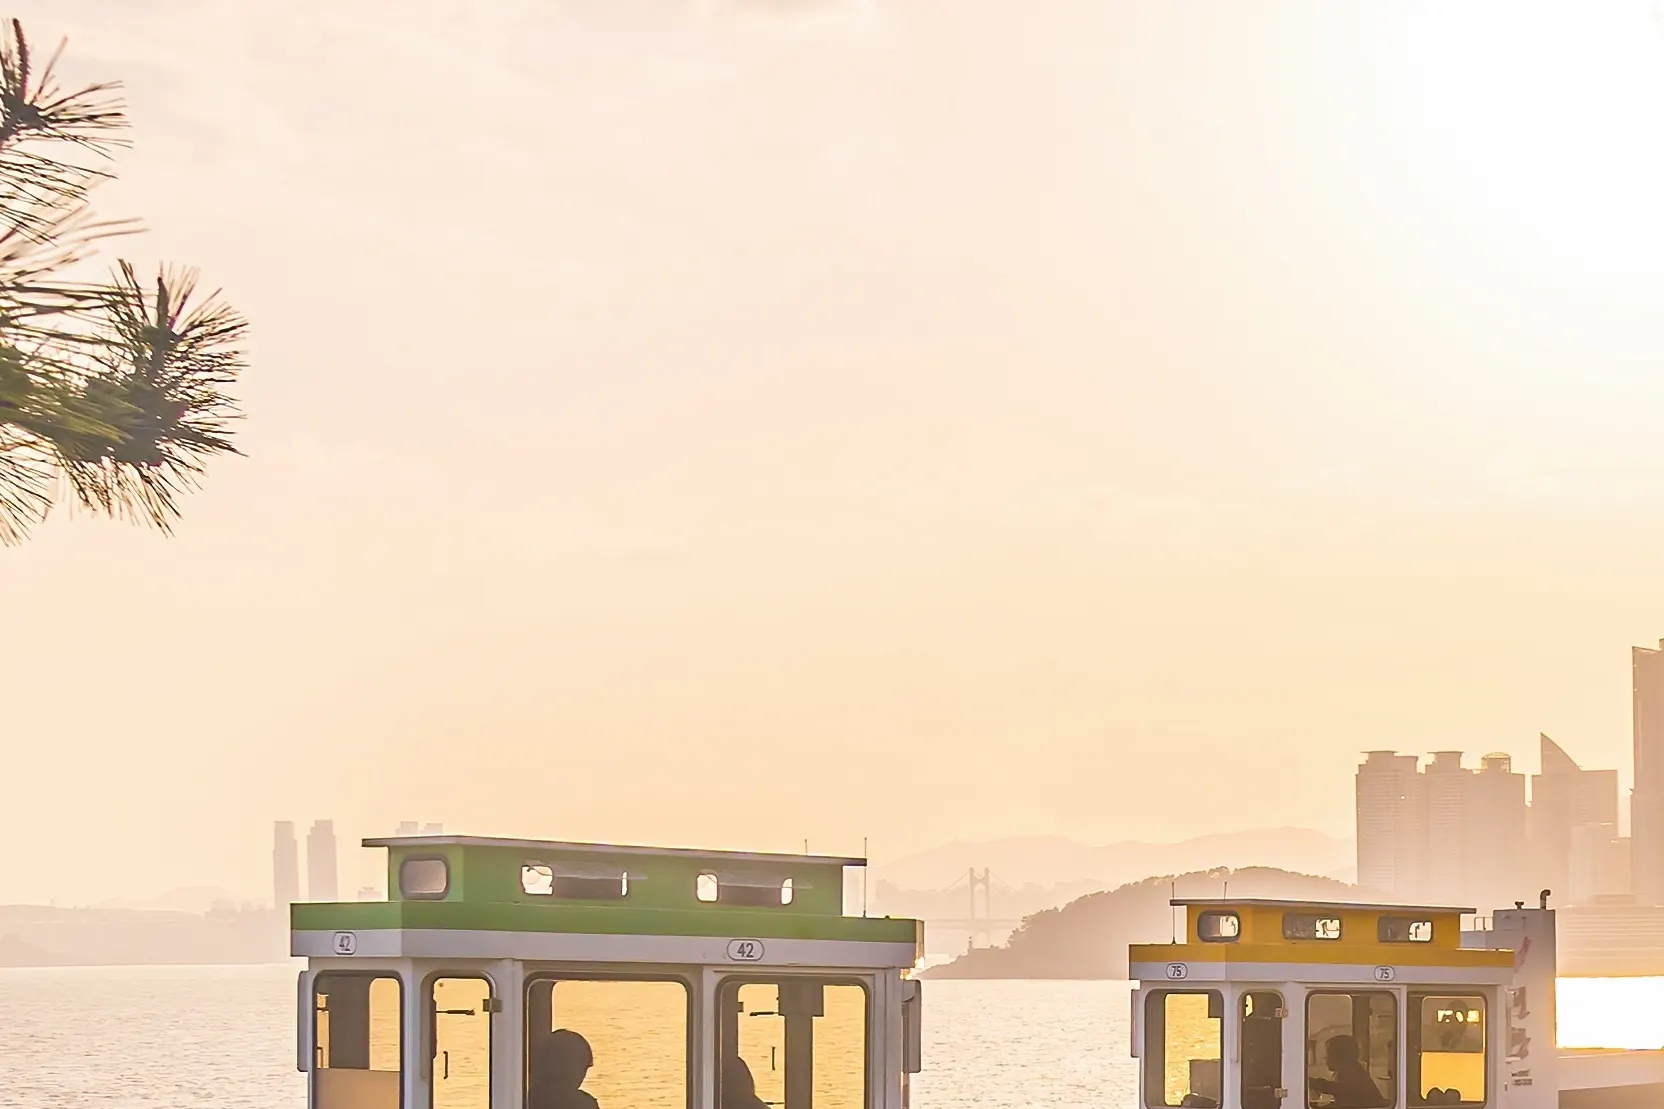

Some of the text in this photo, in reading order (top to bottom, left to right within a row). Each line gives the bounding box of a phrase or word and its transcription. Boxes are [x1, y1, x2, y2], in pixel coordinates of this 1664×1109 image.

[339, 935, 350, 951] 42
[737, 942, 754, 958] 42
[1171, 965, 1182, 977] 75
[1380, 967, 1390, 979] 75
